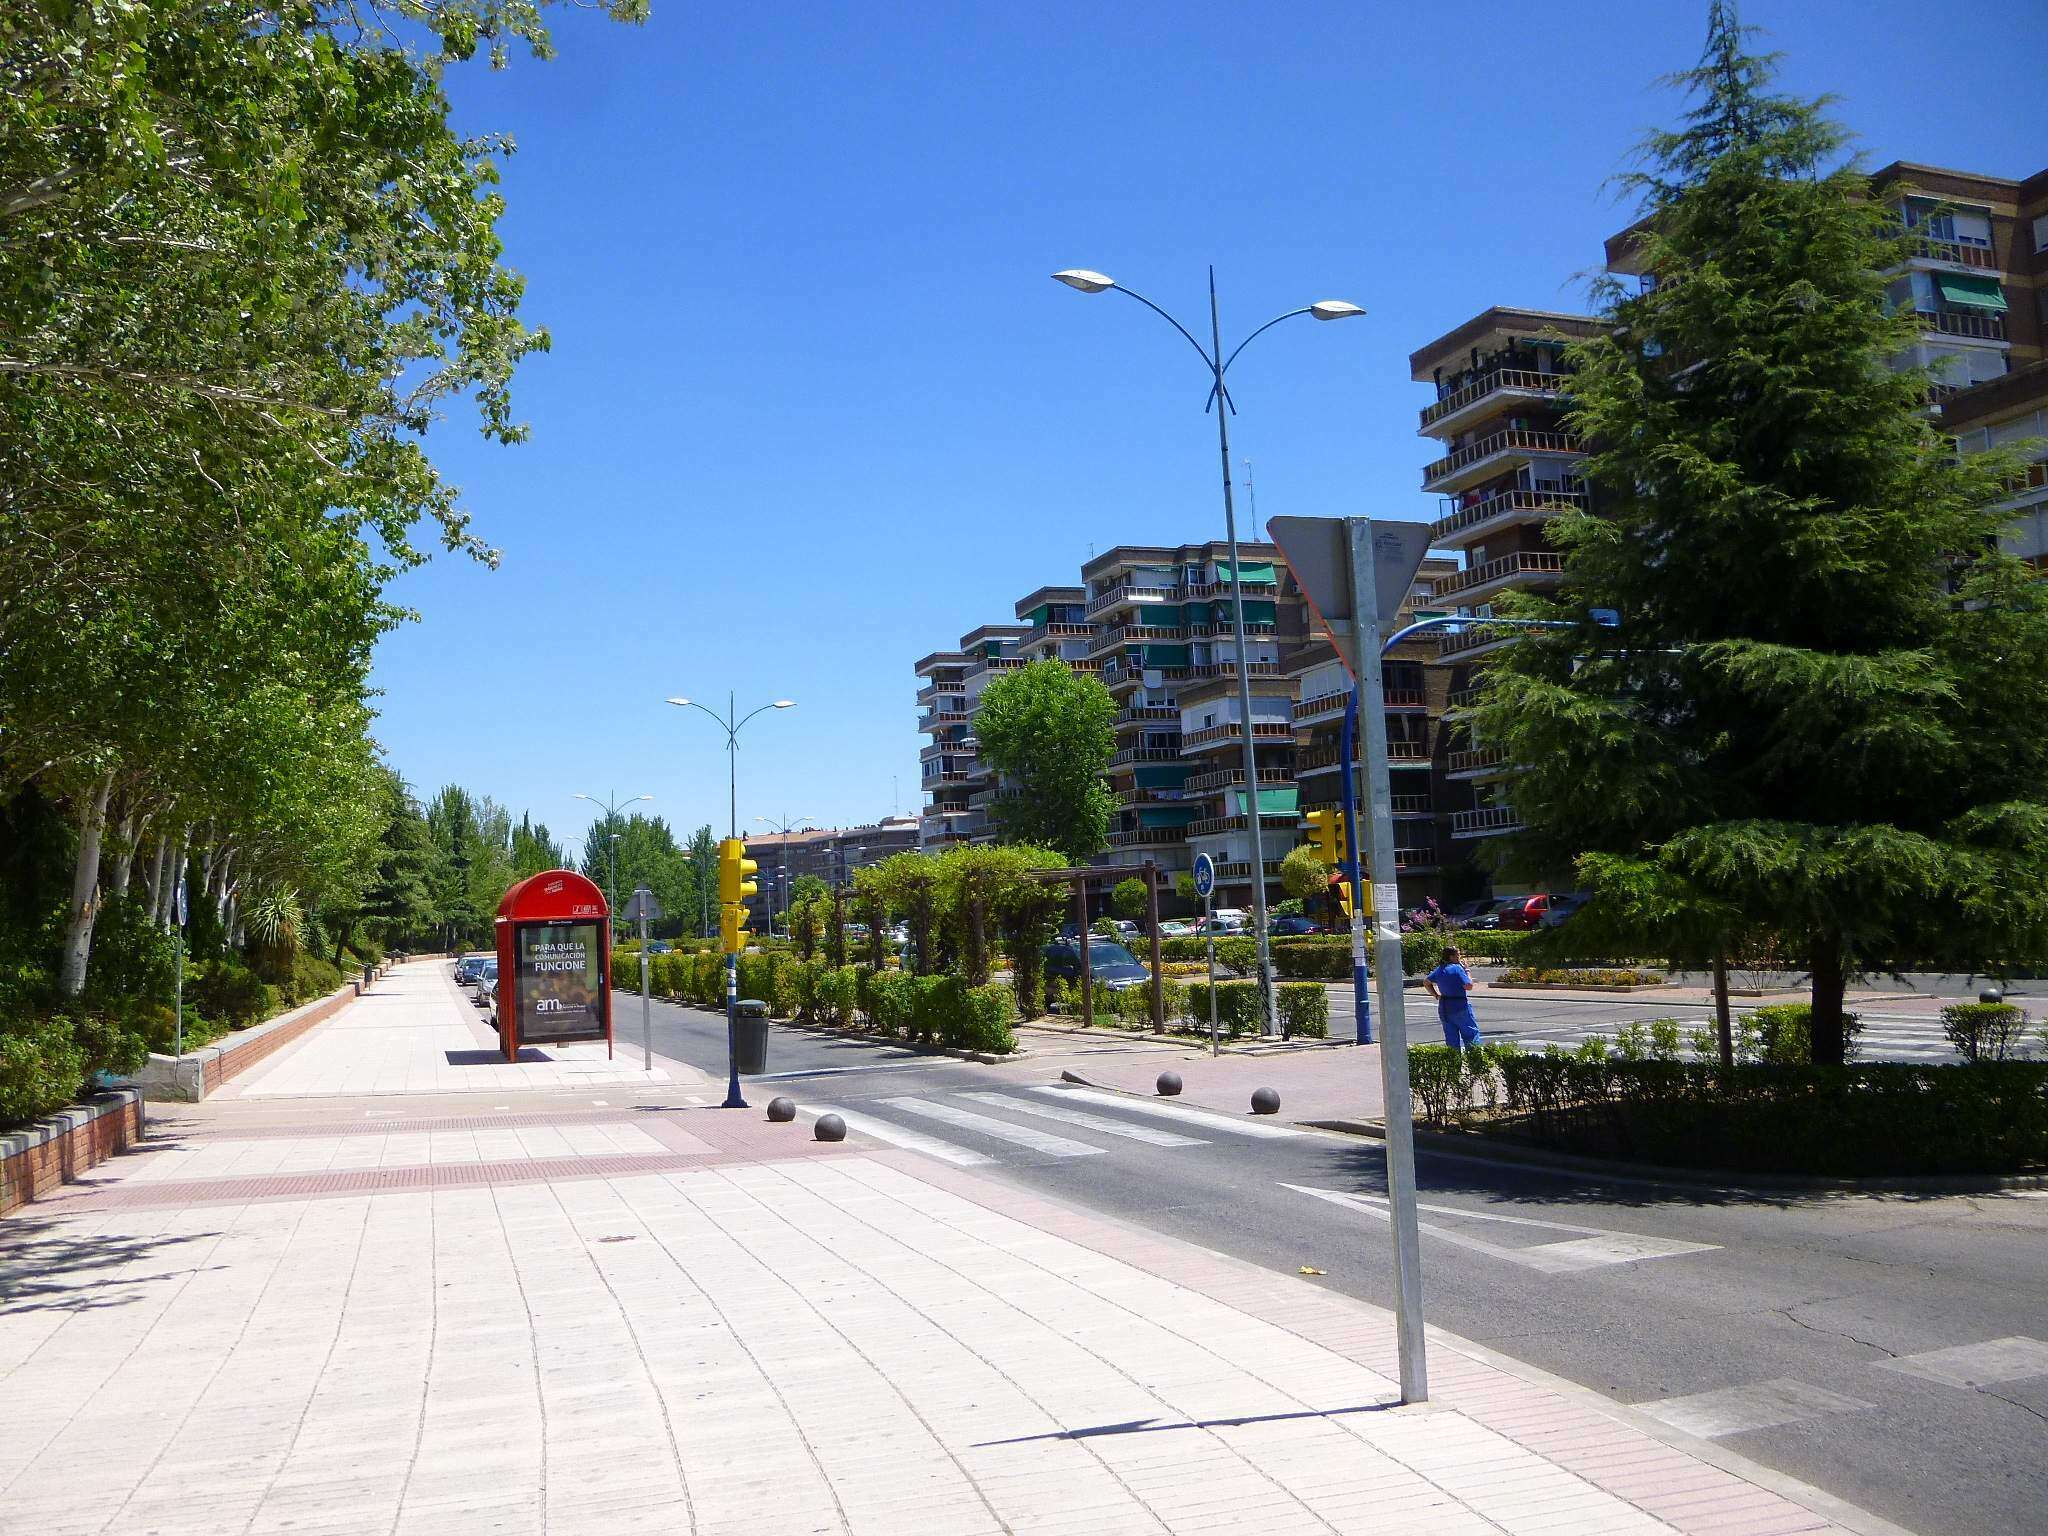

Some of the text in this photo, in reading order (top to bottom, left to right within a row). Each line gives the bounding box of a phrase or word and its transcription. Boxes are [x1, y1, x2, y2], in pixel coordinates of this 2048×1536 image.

[535, 942, 585, 952] PARA QUE LA
[535, 961, 586, 971] FUNCIONE
